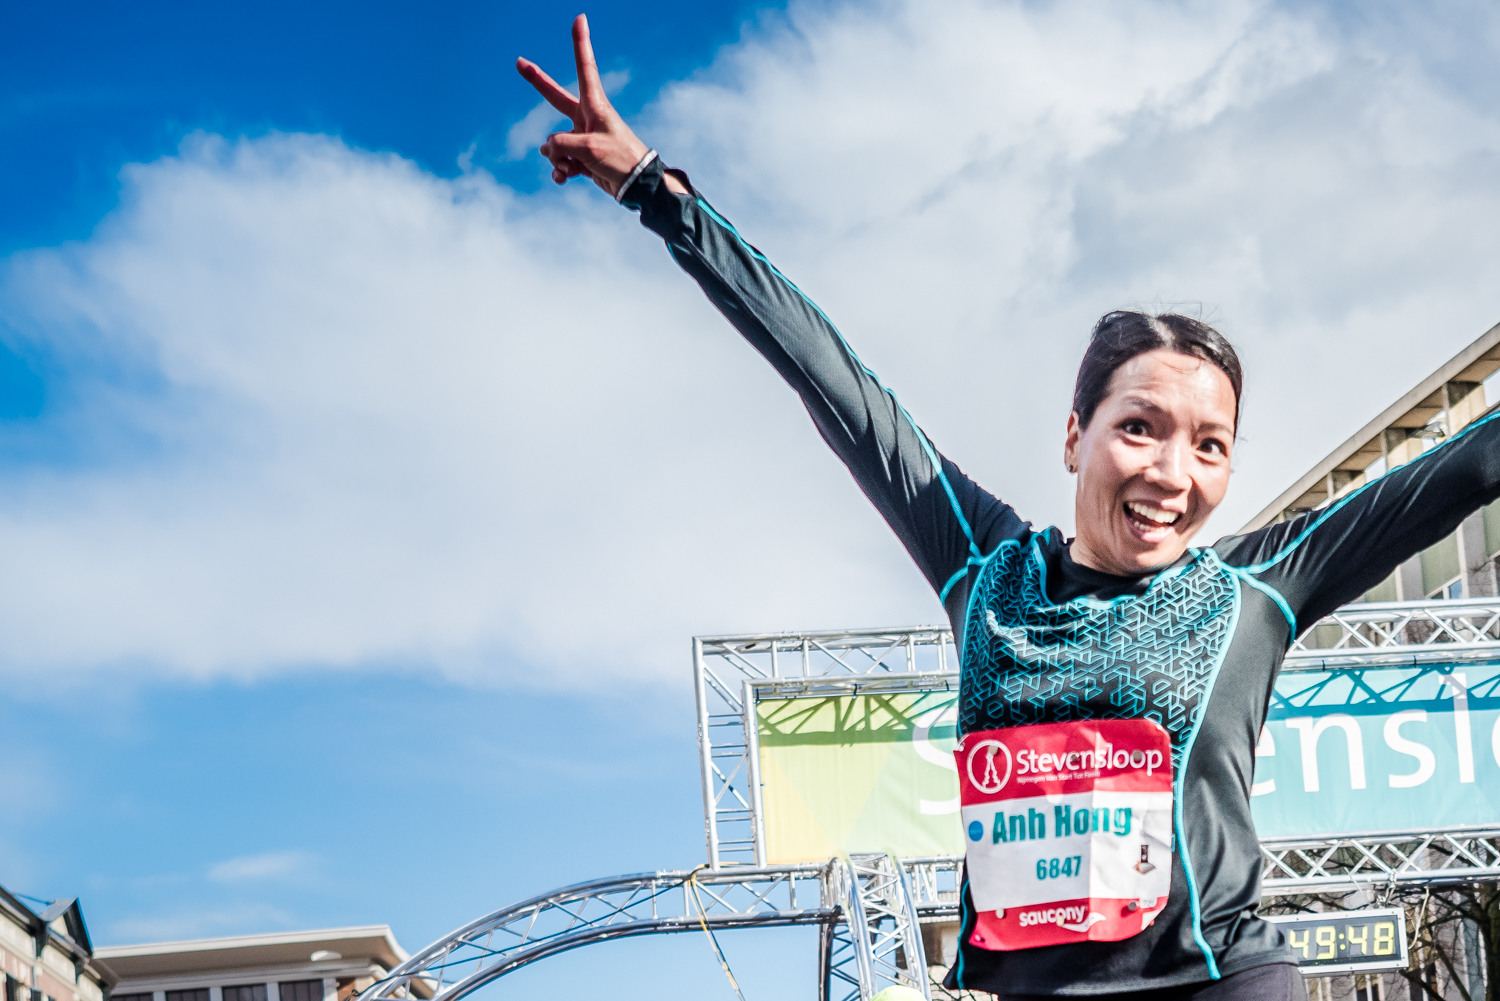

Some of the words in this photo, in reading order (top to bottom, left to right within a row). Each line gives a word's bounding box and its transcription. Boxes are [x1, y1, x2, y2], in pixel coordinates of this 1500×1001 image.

[1016, 743, 1163, 776] Stevensloop
[992, 807, 1046, 844] Anh
[1054, 805, 1132, 836] Hong
[1036, 856, 1082, 881] 6847
[1019, 904, 1088, 927] saucony
[1289, 922, 1395, 959] 49:48
